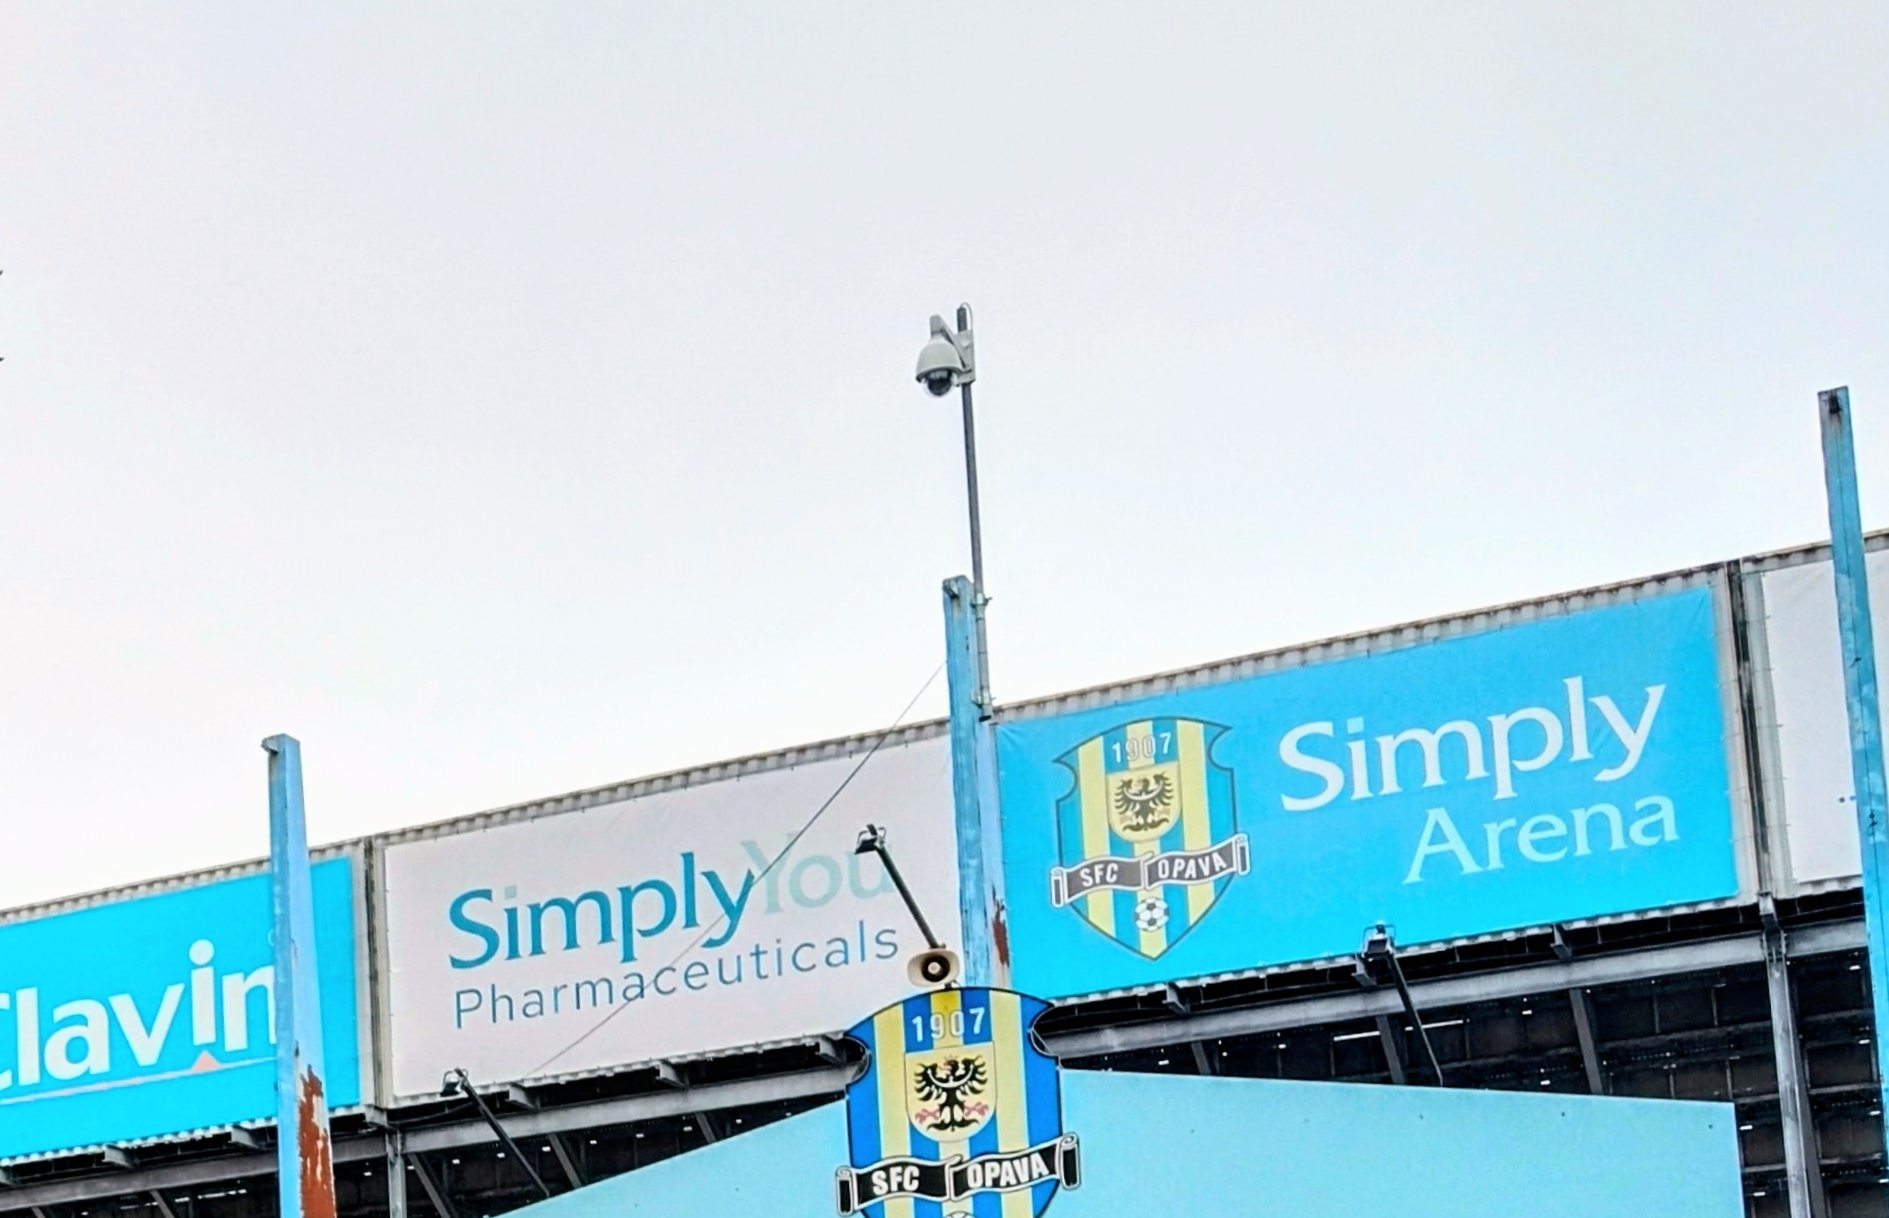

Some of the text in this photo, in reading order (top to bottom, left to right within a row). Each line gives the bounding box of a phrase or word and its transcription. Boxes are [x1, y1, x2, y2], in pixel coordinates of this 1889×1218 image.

[1111, 732, 1172, 764] 1907
[1278, 676, 1666, 814] Simply
[1079, 851, 1227, 888] SFC OPAVA
[1403, 794, 1680, 886] Arena
[448, 831, 897, 970] SimplyYou
[453, 919, 899, 1030] Pharmaceuticals
[911, 1006, 986, 1043] 1907
[871, 1152, 1049, 1196] SFC OPAVA
